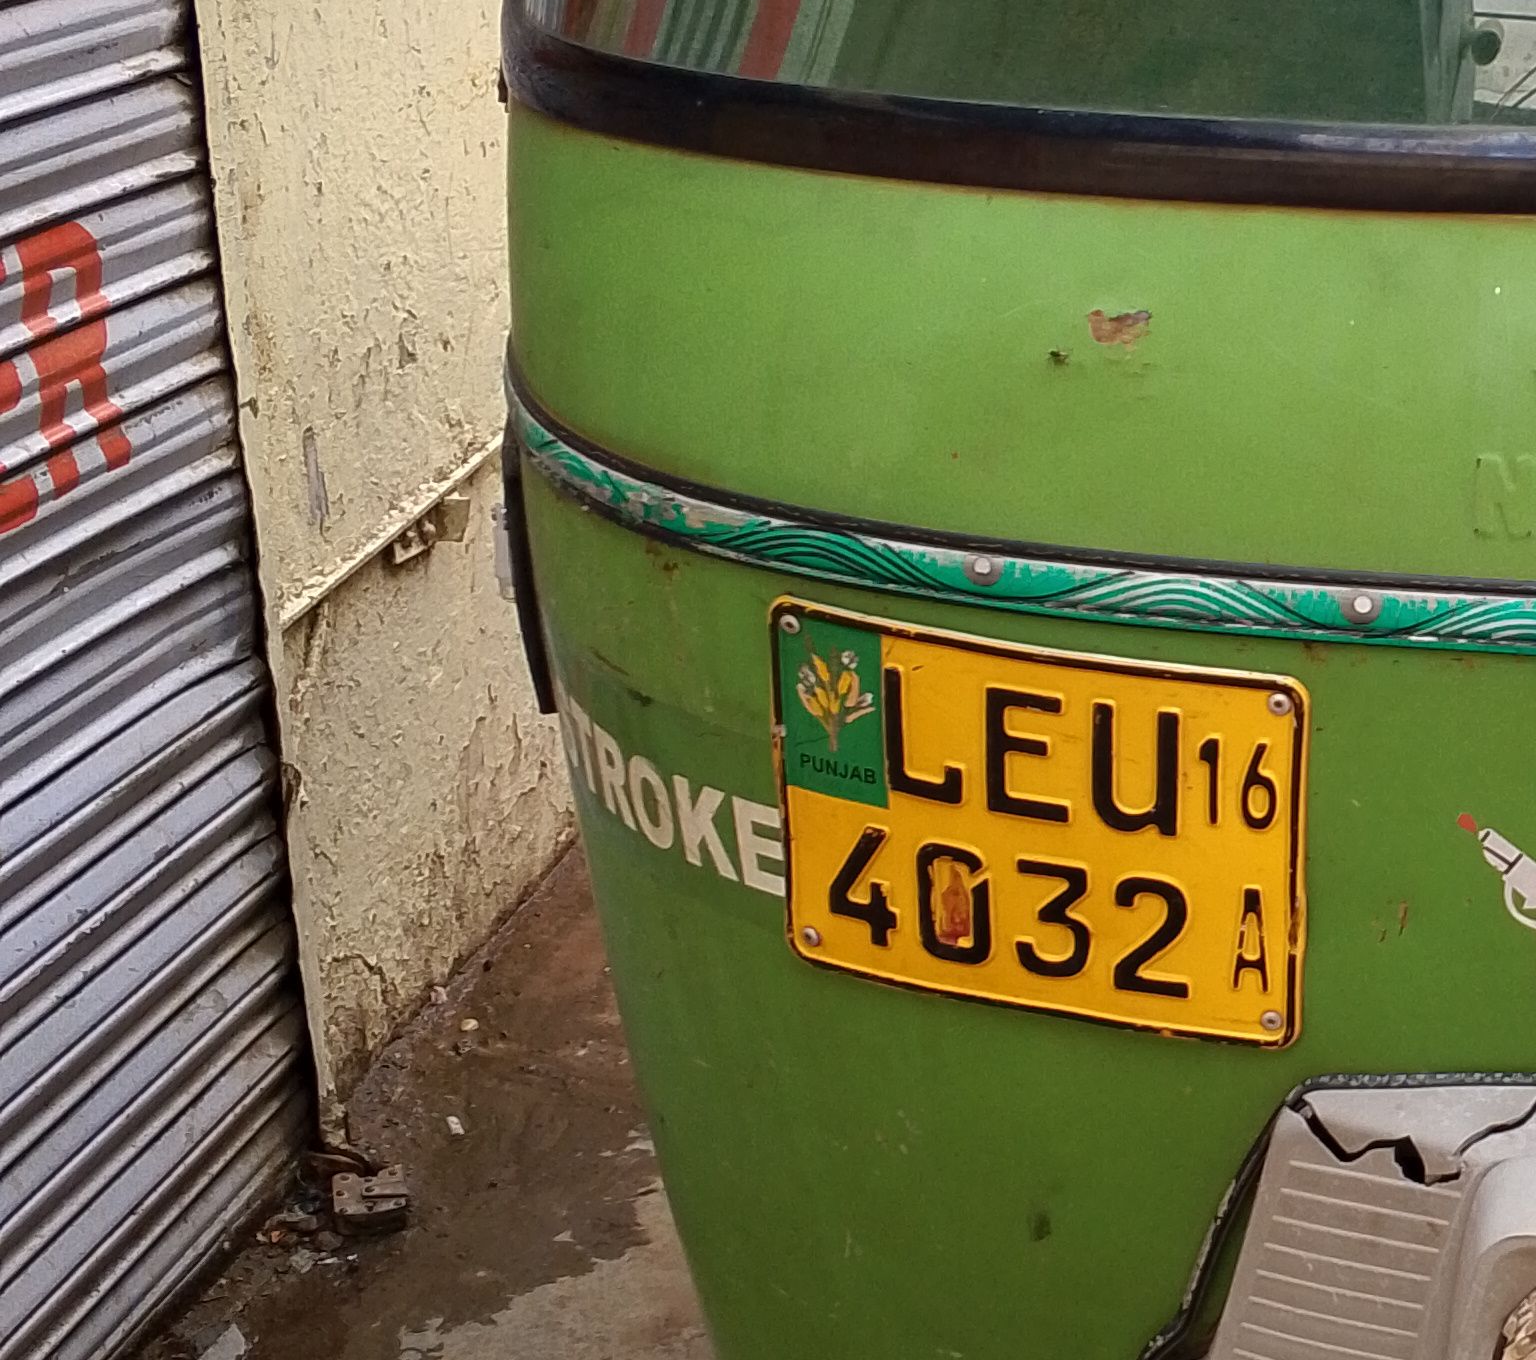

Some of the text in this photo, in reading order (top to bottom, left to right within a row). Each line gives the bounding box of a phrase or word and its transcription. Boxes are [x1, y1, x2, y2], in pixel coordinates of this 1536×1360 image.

[799, 751, 878, 785] PUNJAB
[882, 665, 1278, 837] LEU 16
[828, 826, 1272, 999] 4032 A
